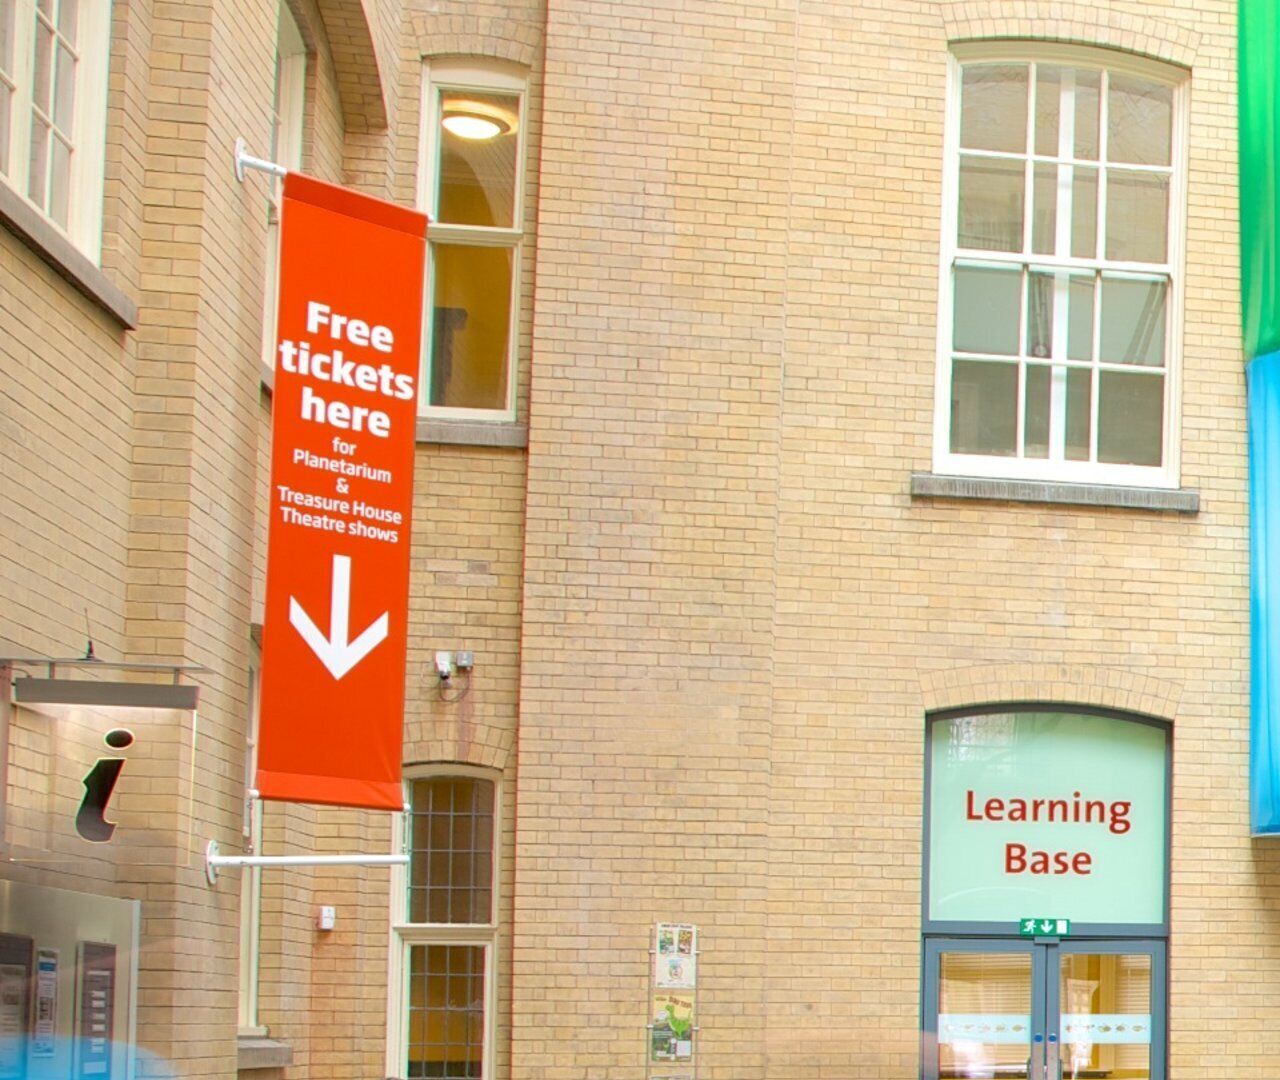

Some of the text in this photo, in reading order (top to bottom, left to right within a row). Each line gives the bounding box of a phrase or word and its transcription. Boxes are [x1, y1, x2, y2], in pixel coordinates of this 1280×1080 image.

[306, 300, 394, 353] Free
[279, 339, 414, 400] tickets
[301, 386, 391, 438] here
[332, 436, 357, 456] for
[293, 448, 392, 483] Planetarium
[277, 485, 403, 524] Treasure House
[336, 478, 349, 494] &
[280, 506, 399, 543] Theatre shows
[966, 790, 1131, 834] Learning
[1005, 843, 1092, 875] Base
